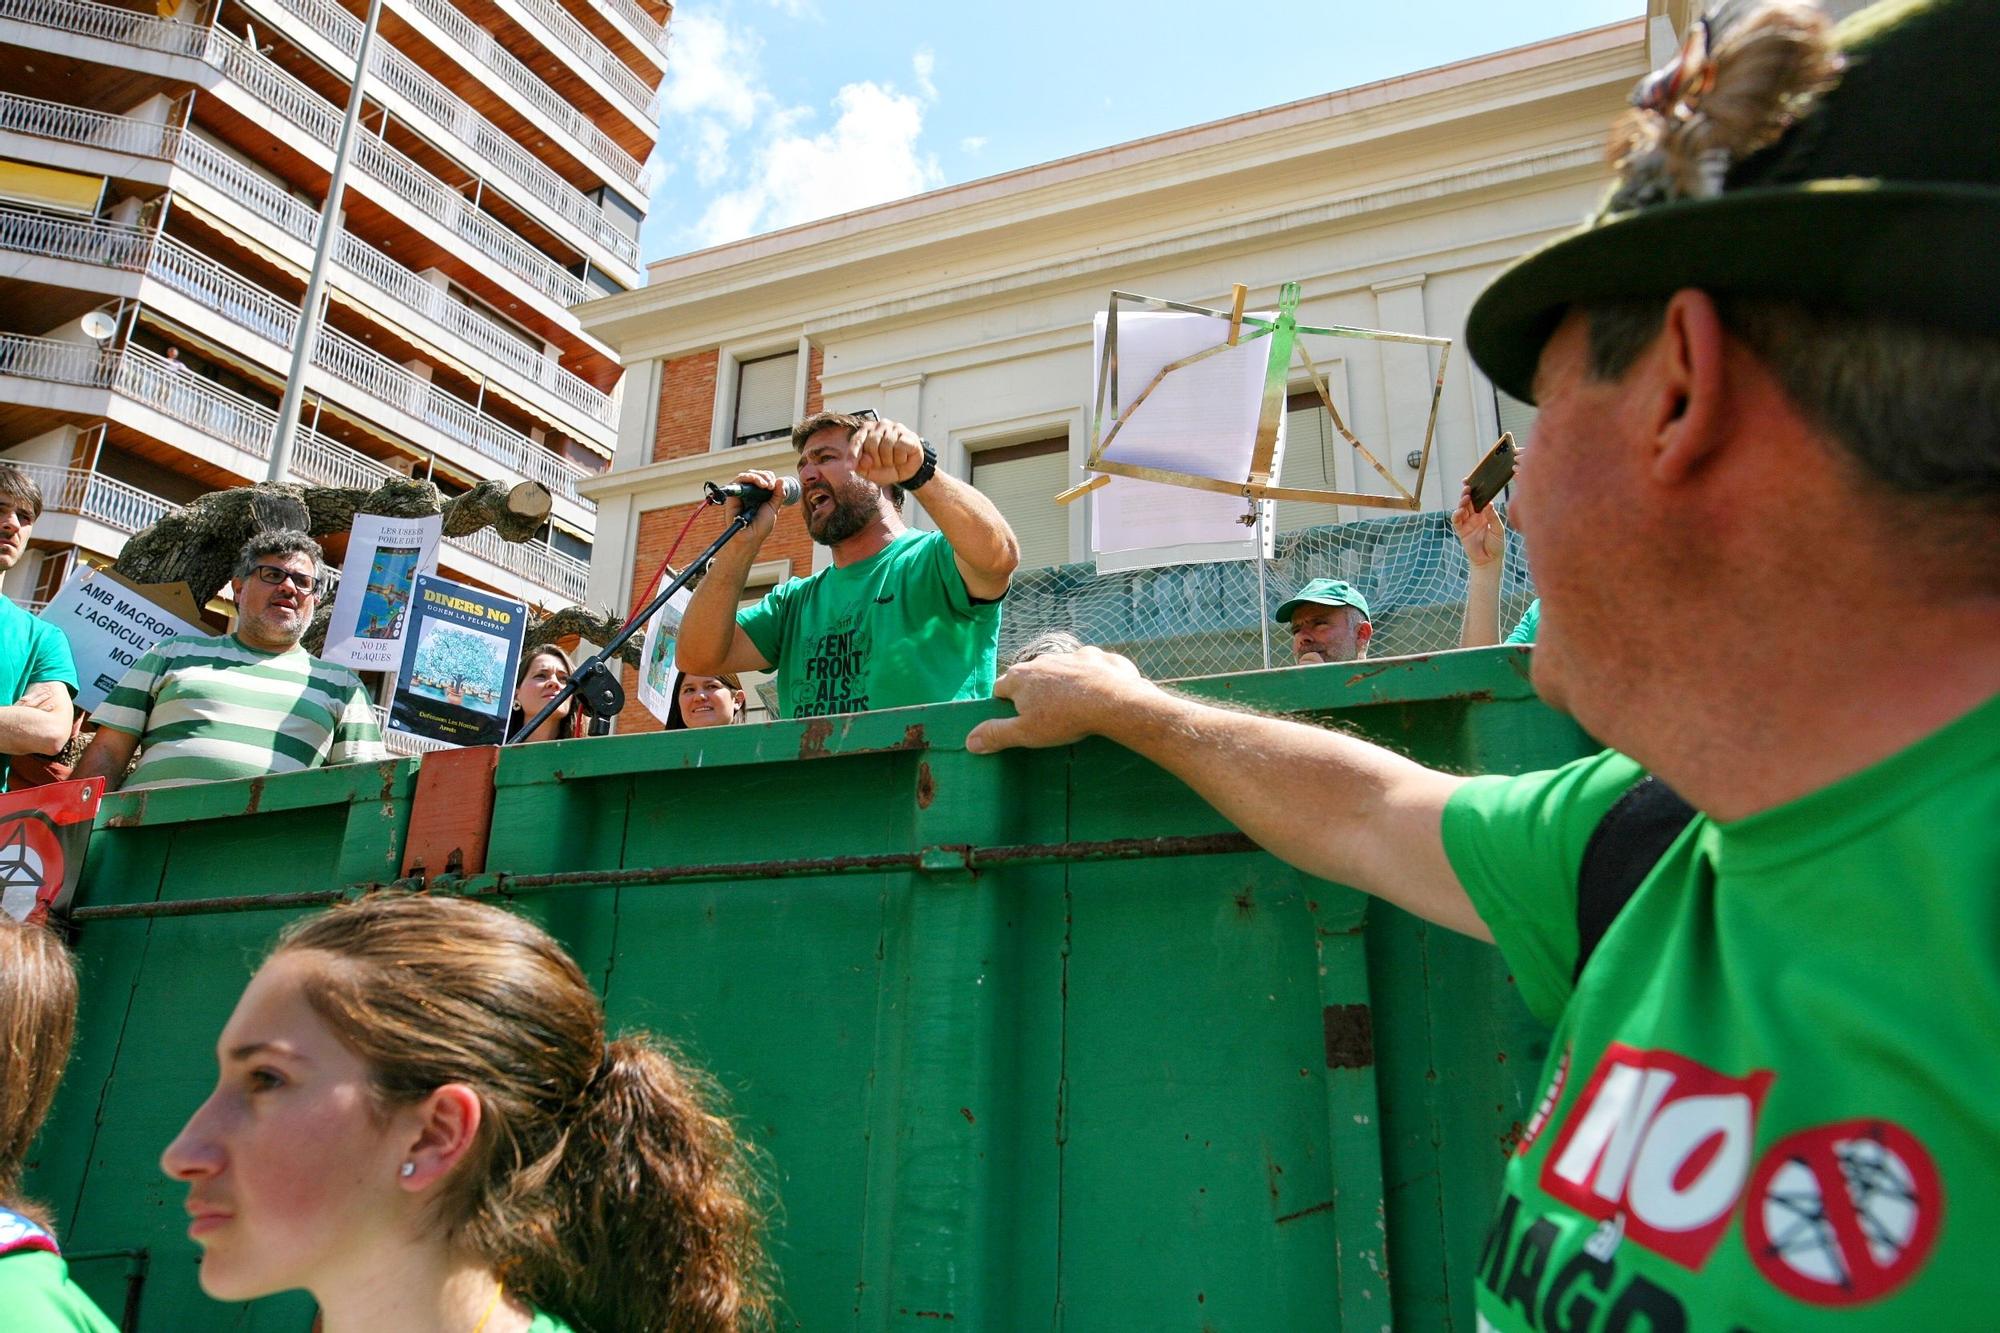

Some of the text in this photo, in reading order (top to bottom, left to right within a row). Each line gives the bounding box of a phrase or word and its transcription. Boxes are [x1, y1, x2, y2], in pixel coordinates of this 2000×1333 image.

[80, 583, 115, 606] AMB
[424, 589, 511, 624] DINERS NO
[351, 651, 392, 662] PLAQUES
[361, 641, 388, 651] NO DE
[816, 629, 857, 657] FENT
[806, 651, 863, 680] FRONT
[816, 676, 851, 702] ALS
[1553, 1062, 1752, 1233] NO
